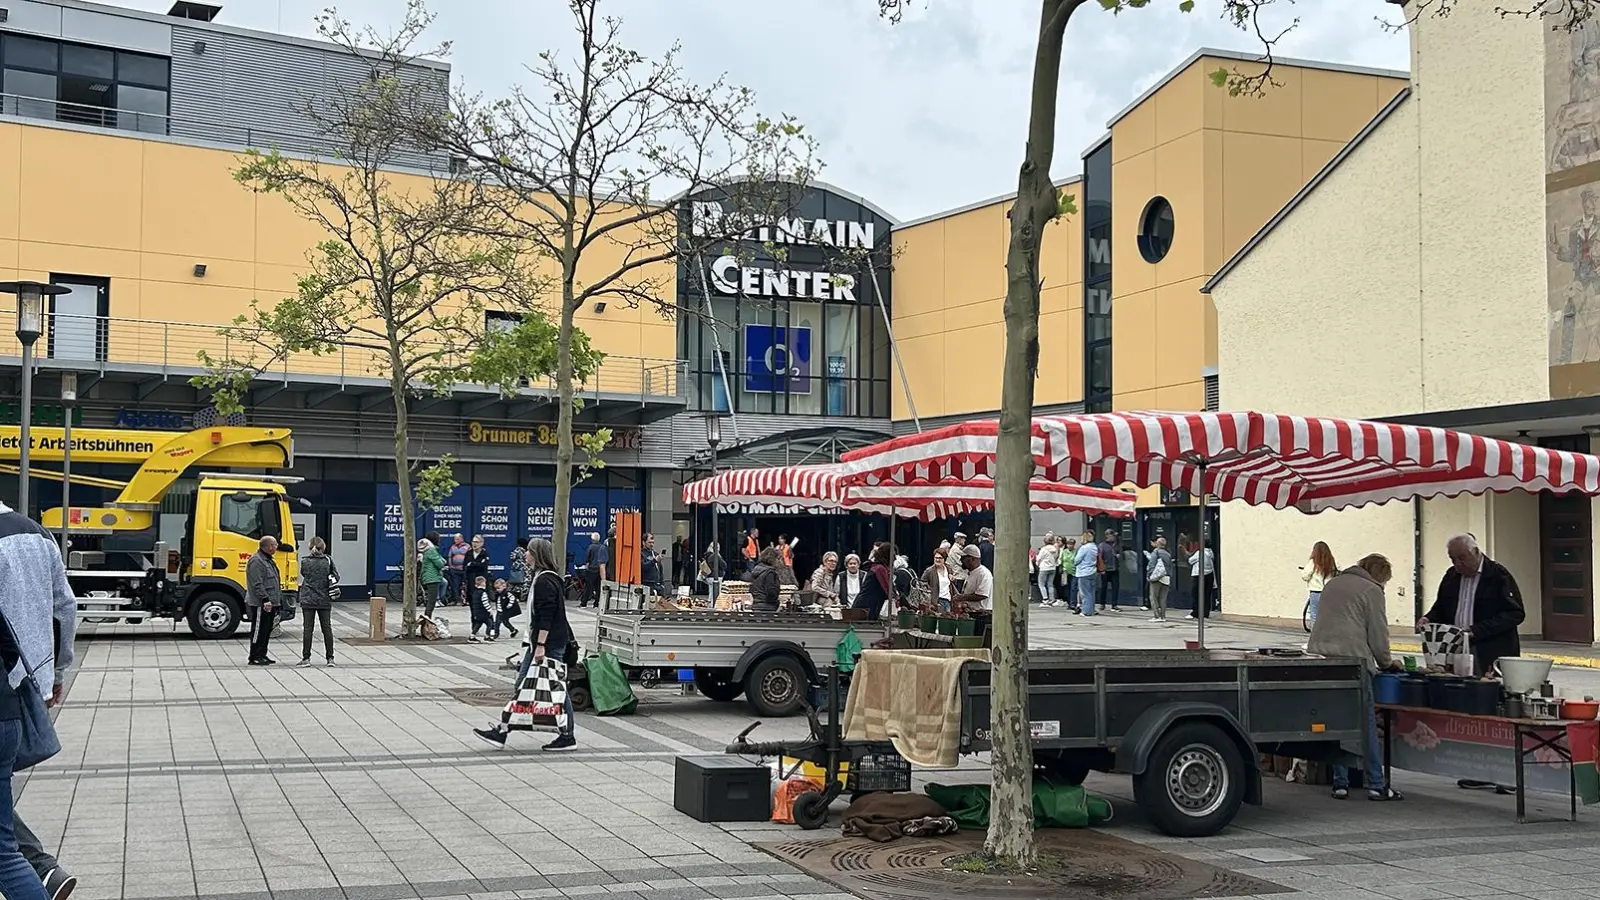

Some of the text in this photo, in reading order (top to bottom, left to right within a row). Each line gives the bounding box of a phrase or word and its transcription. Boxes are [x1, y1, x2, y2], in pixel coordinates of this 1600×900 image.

[710, 255, 857, 301] CENTER
[469, 422, 534, 444] Brunner
[39, 436, 153, 453] Arbeitsbühnen
[384, 504, 405, 516] ZE
[481, 506, 508, 514] JETZT
[527, 507, 554, 516] GANZ
[572, 508, 598, 516] MEHR
[480, 515, 508, 523] SCHON
[527, 516, 554, 525] NEUE
[572, 518, 598, 527] WOW
[433, 519, 462, 529] LIEBE
